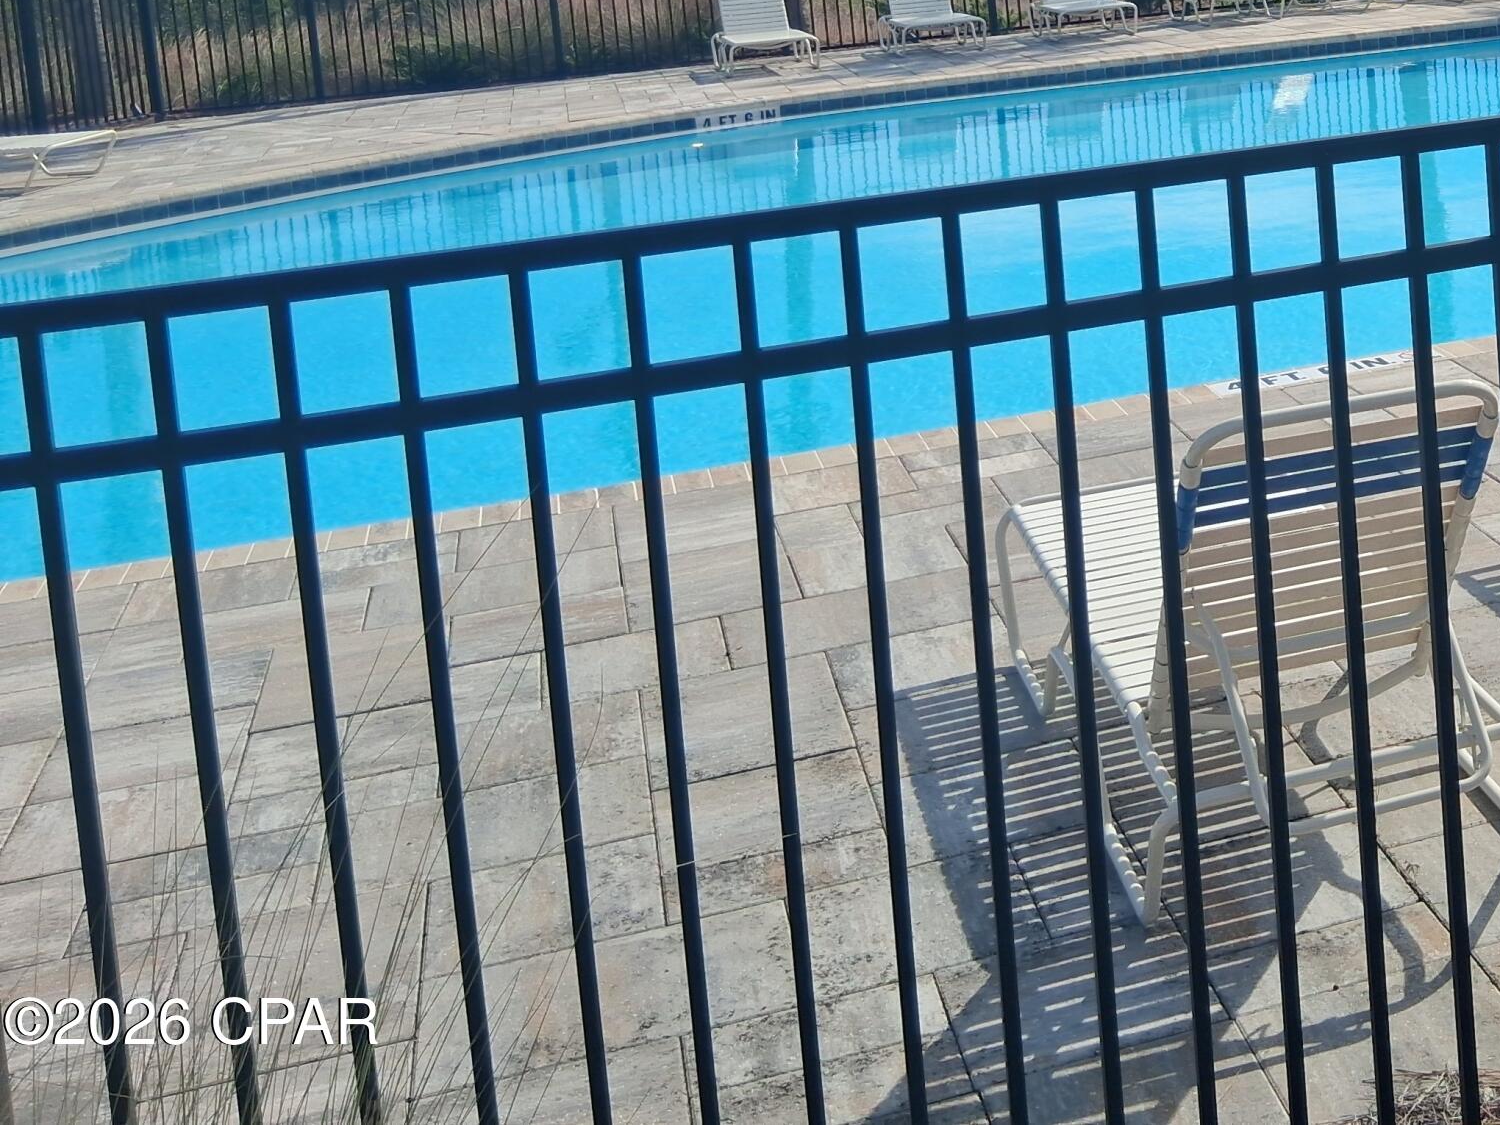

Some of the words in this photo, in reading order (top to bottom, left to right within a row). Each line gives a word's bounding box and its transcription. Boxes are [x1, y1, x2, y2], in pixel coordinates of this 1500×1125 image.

[719, 115, 737, 125] FT
[745, 112, 753, 122] 6
[760, 109, 776, 119] IN
